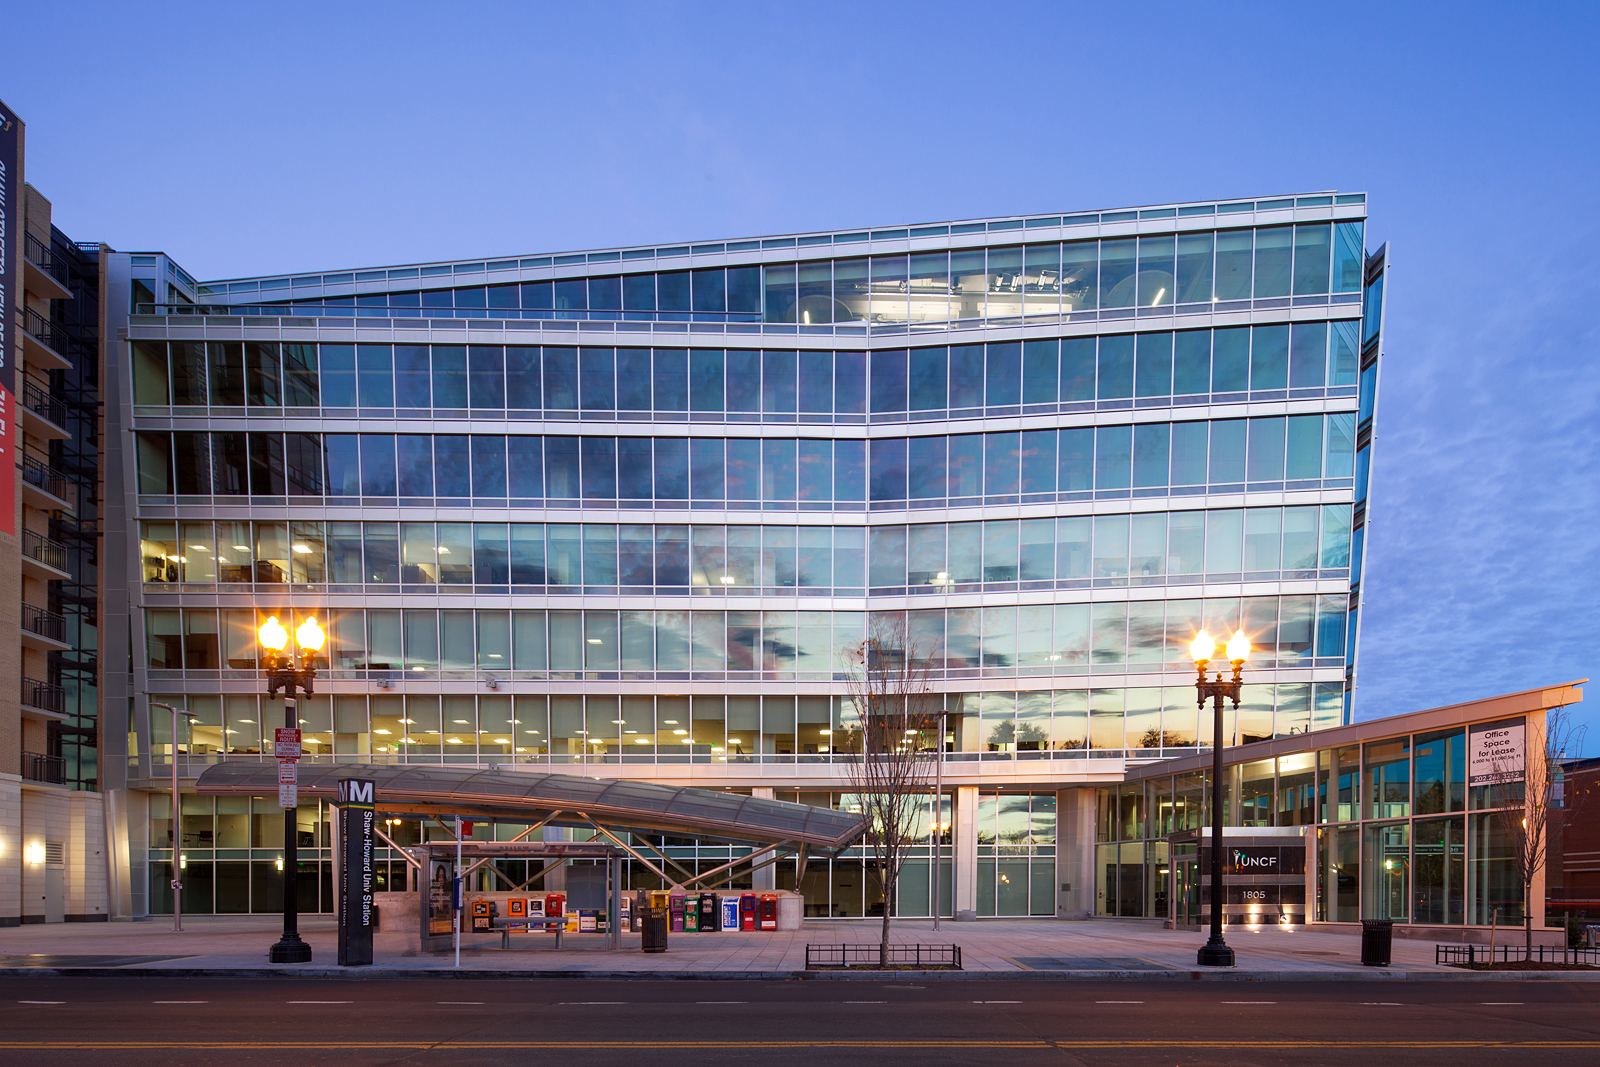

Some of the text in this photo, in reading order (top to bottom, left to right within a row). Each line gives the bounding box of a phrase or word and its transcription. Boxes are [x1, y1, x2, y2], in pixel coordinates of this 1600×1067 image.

[1485, 730, 1509, 738] Office
[1484, 740, 1510, 748] Space
[350, 780, 373, 803] M
[1241, 857, 1276, 866] UNCF
[363, 811, 372, 926] Shaw-Howard Univ Station
